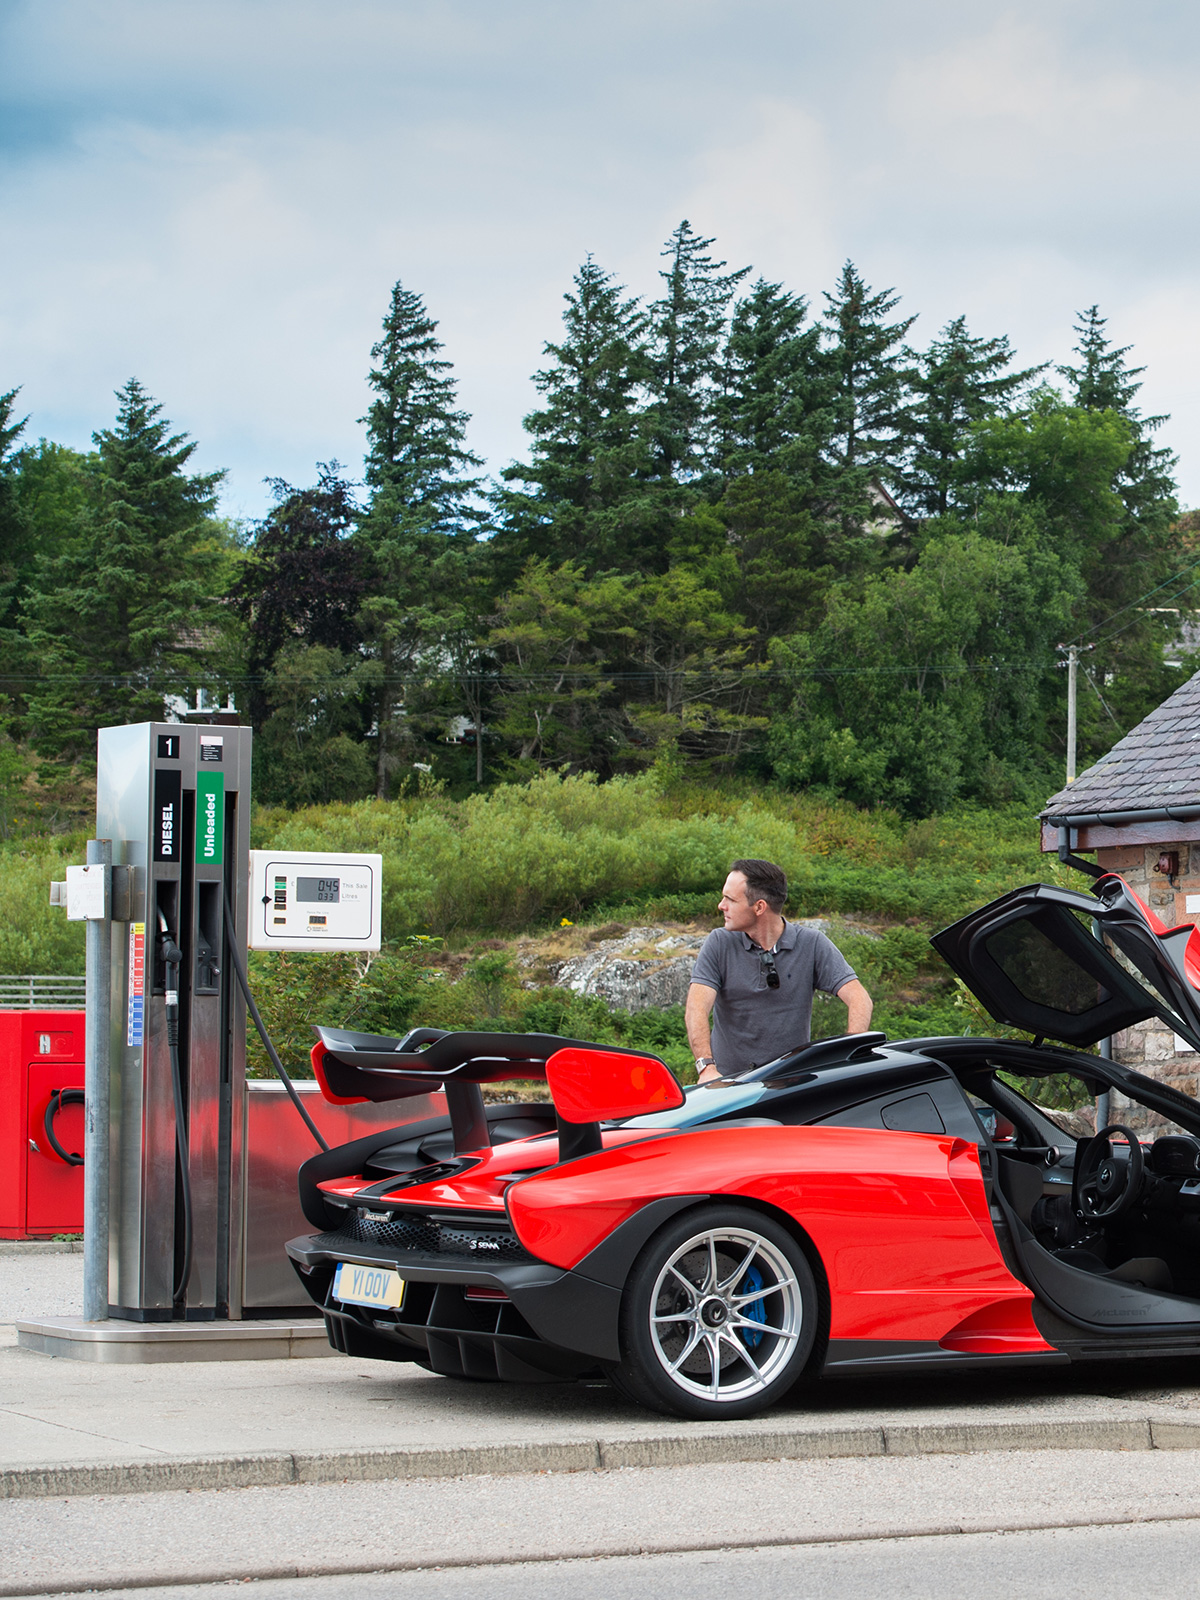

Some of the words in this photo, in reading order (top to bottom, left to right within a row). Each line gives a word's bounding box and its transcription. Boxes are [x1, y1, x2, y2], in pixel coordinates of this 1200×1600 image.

[166, 738, 172, 756] 1
[161, 803, 173, 855] DIESEL
[204, 793, 216, 857] Unleaded
[318, 880, 339, 892] 0.45
[364, 1213, 388, 1221] McLaren
